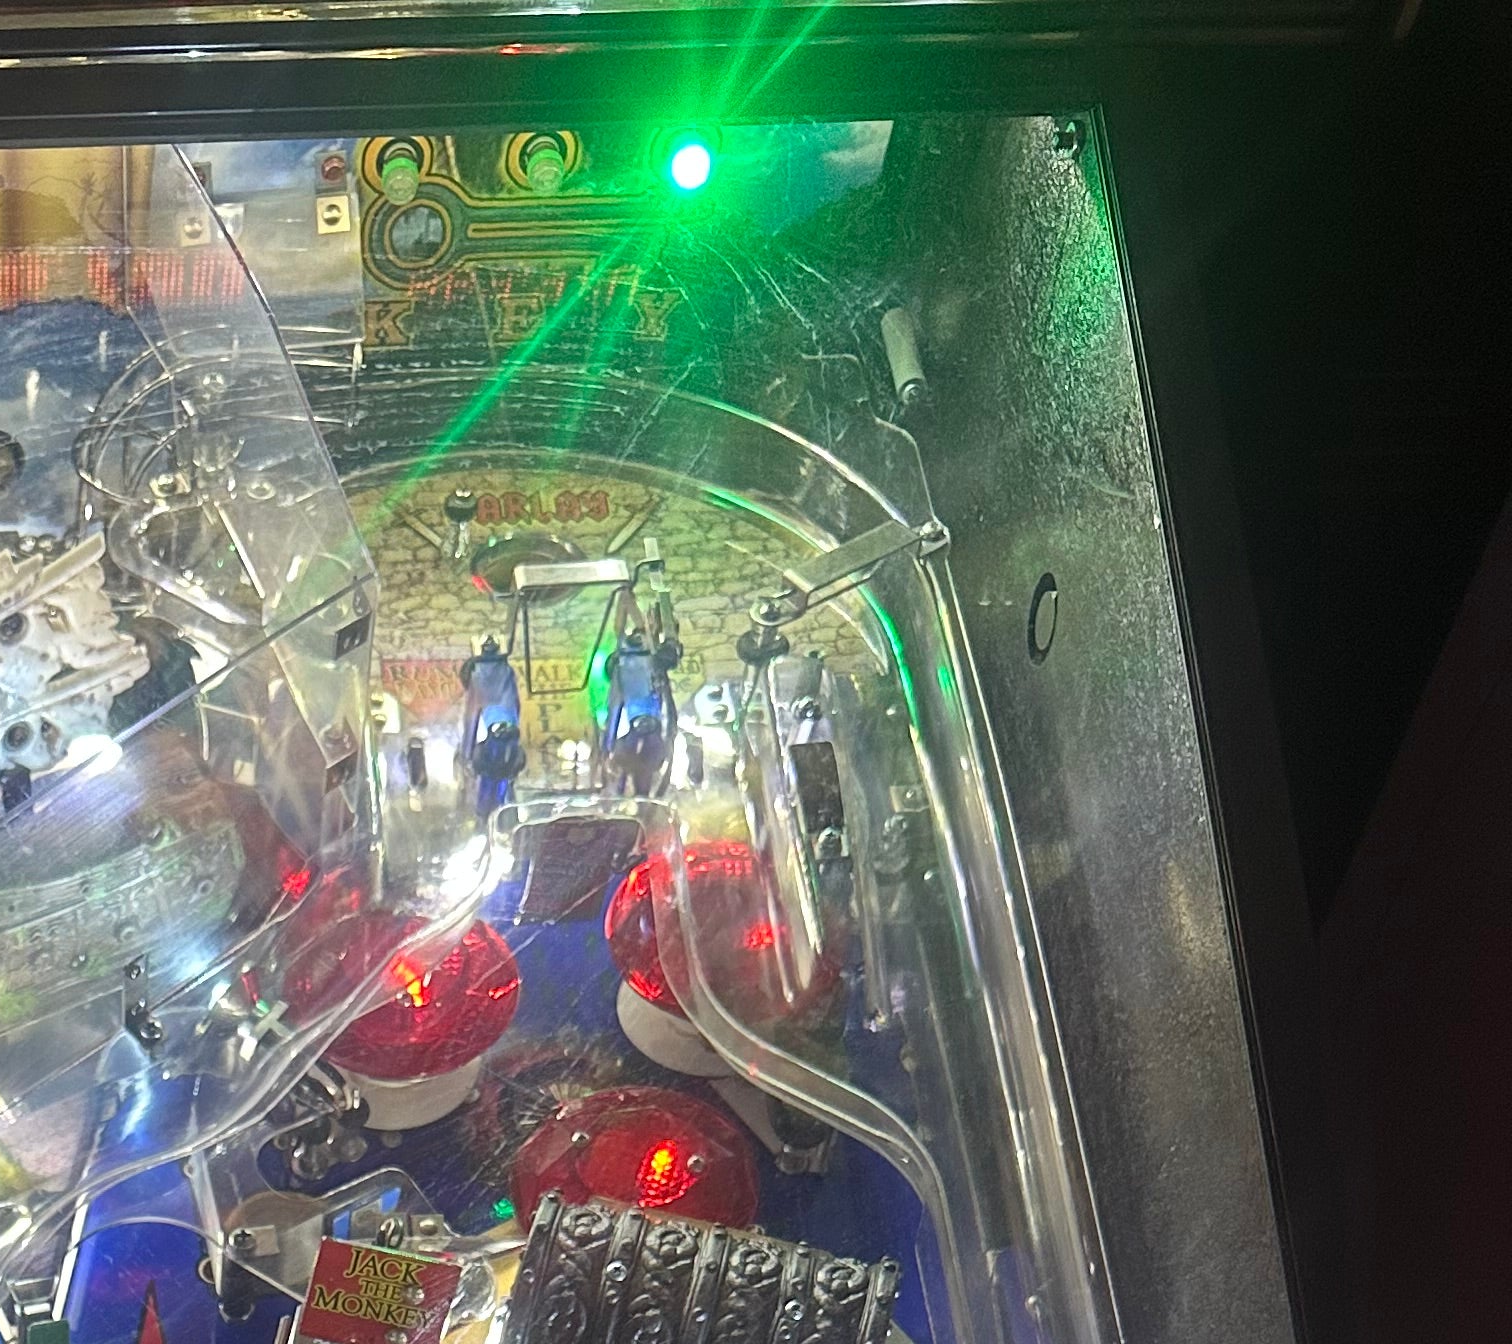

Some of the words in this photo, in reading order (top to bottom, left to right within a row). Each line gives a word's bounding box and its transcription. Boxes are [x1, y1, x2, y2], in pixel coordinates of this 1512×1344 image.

[344, 1246, 425, 1286] JACK
[312, 1288, 431, 1330] MONKEY
[359, 1281, 401, 1299] THE
